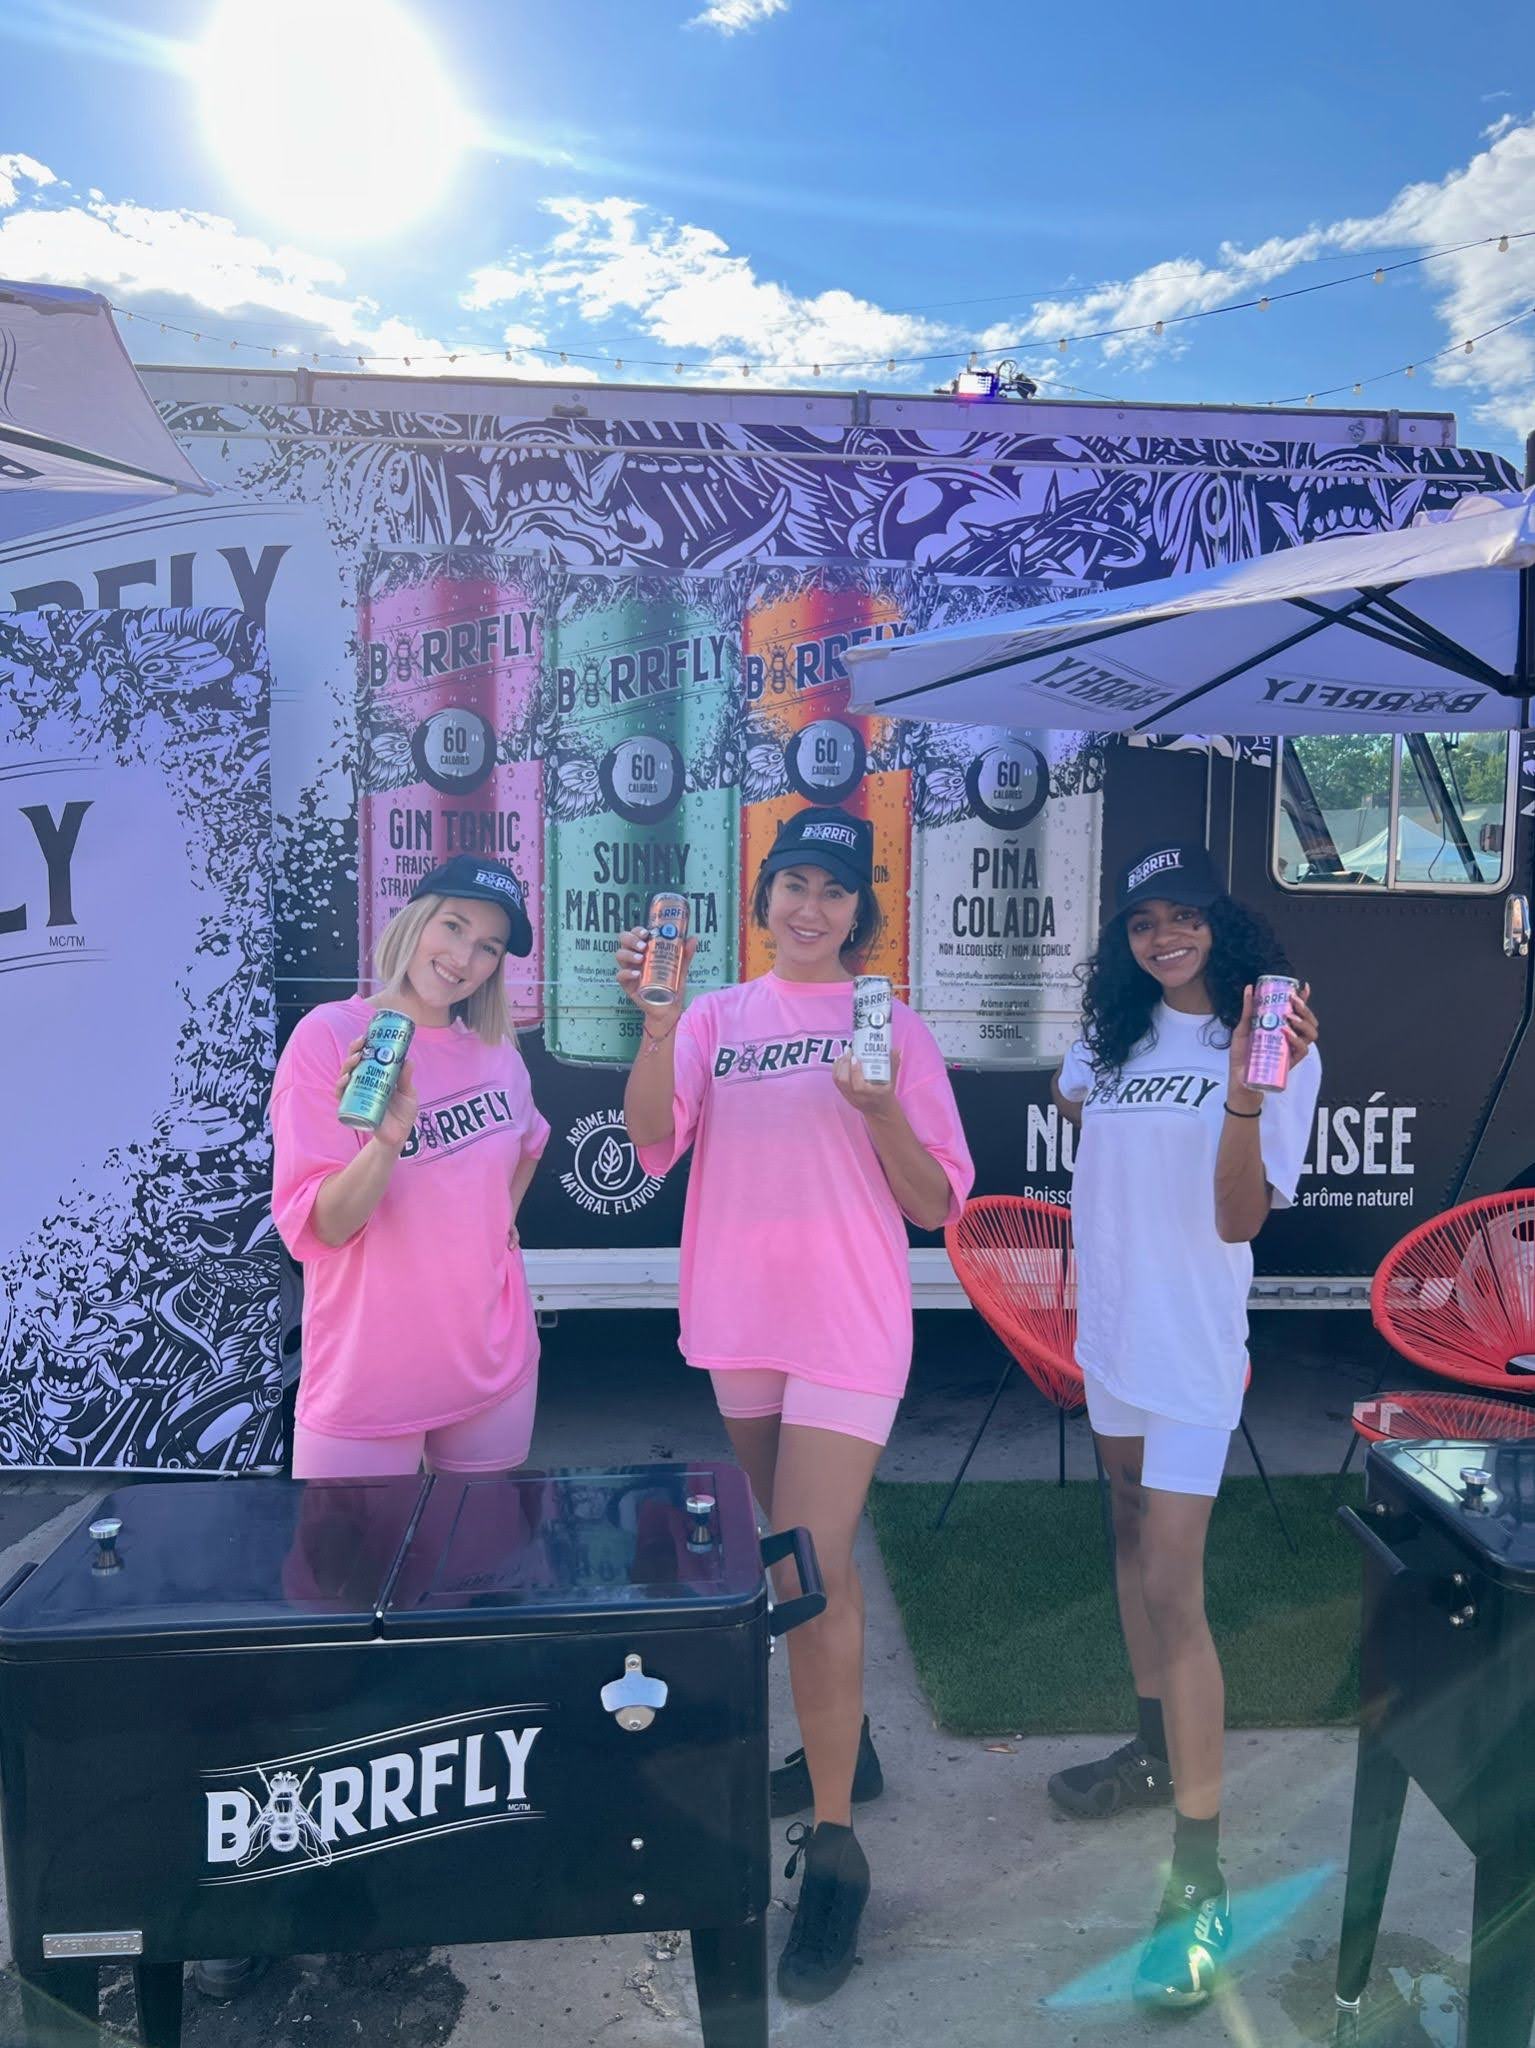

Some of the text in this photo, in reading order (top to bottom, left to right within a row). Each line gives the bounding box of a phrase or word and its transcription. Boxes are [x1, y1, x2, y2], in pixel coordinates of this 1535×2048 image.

[443, 727, 468, 752] 60
[815, 738, 838, 763] 60
[630, 754, 656, 780] 60
[997, 761, 1020, 788] 60
[389, 808, 521, 852] GIN TONIC
[593, 841, 691, 885] SUNNY
[972, 839, 1039, 889] PIÑA
[565, 889, 719, 934] MARGTA
[952, 896, 1056, 938] COLADA
[49, 935, 86, 947] MC/TM
[979, 1024, 1023, 1039] 355mL
[566, 1110, 606, 1147] ARÔME
[559, 1172, 610, 1215] NATURAL
[1303, 1187, 1353, 1206] arôme
[1357, 1187, 1413, 1206] naturel
